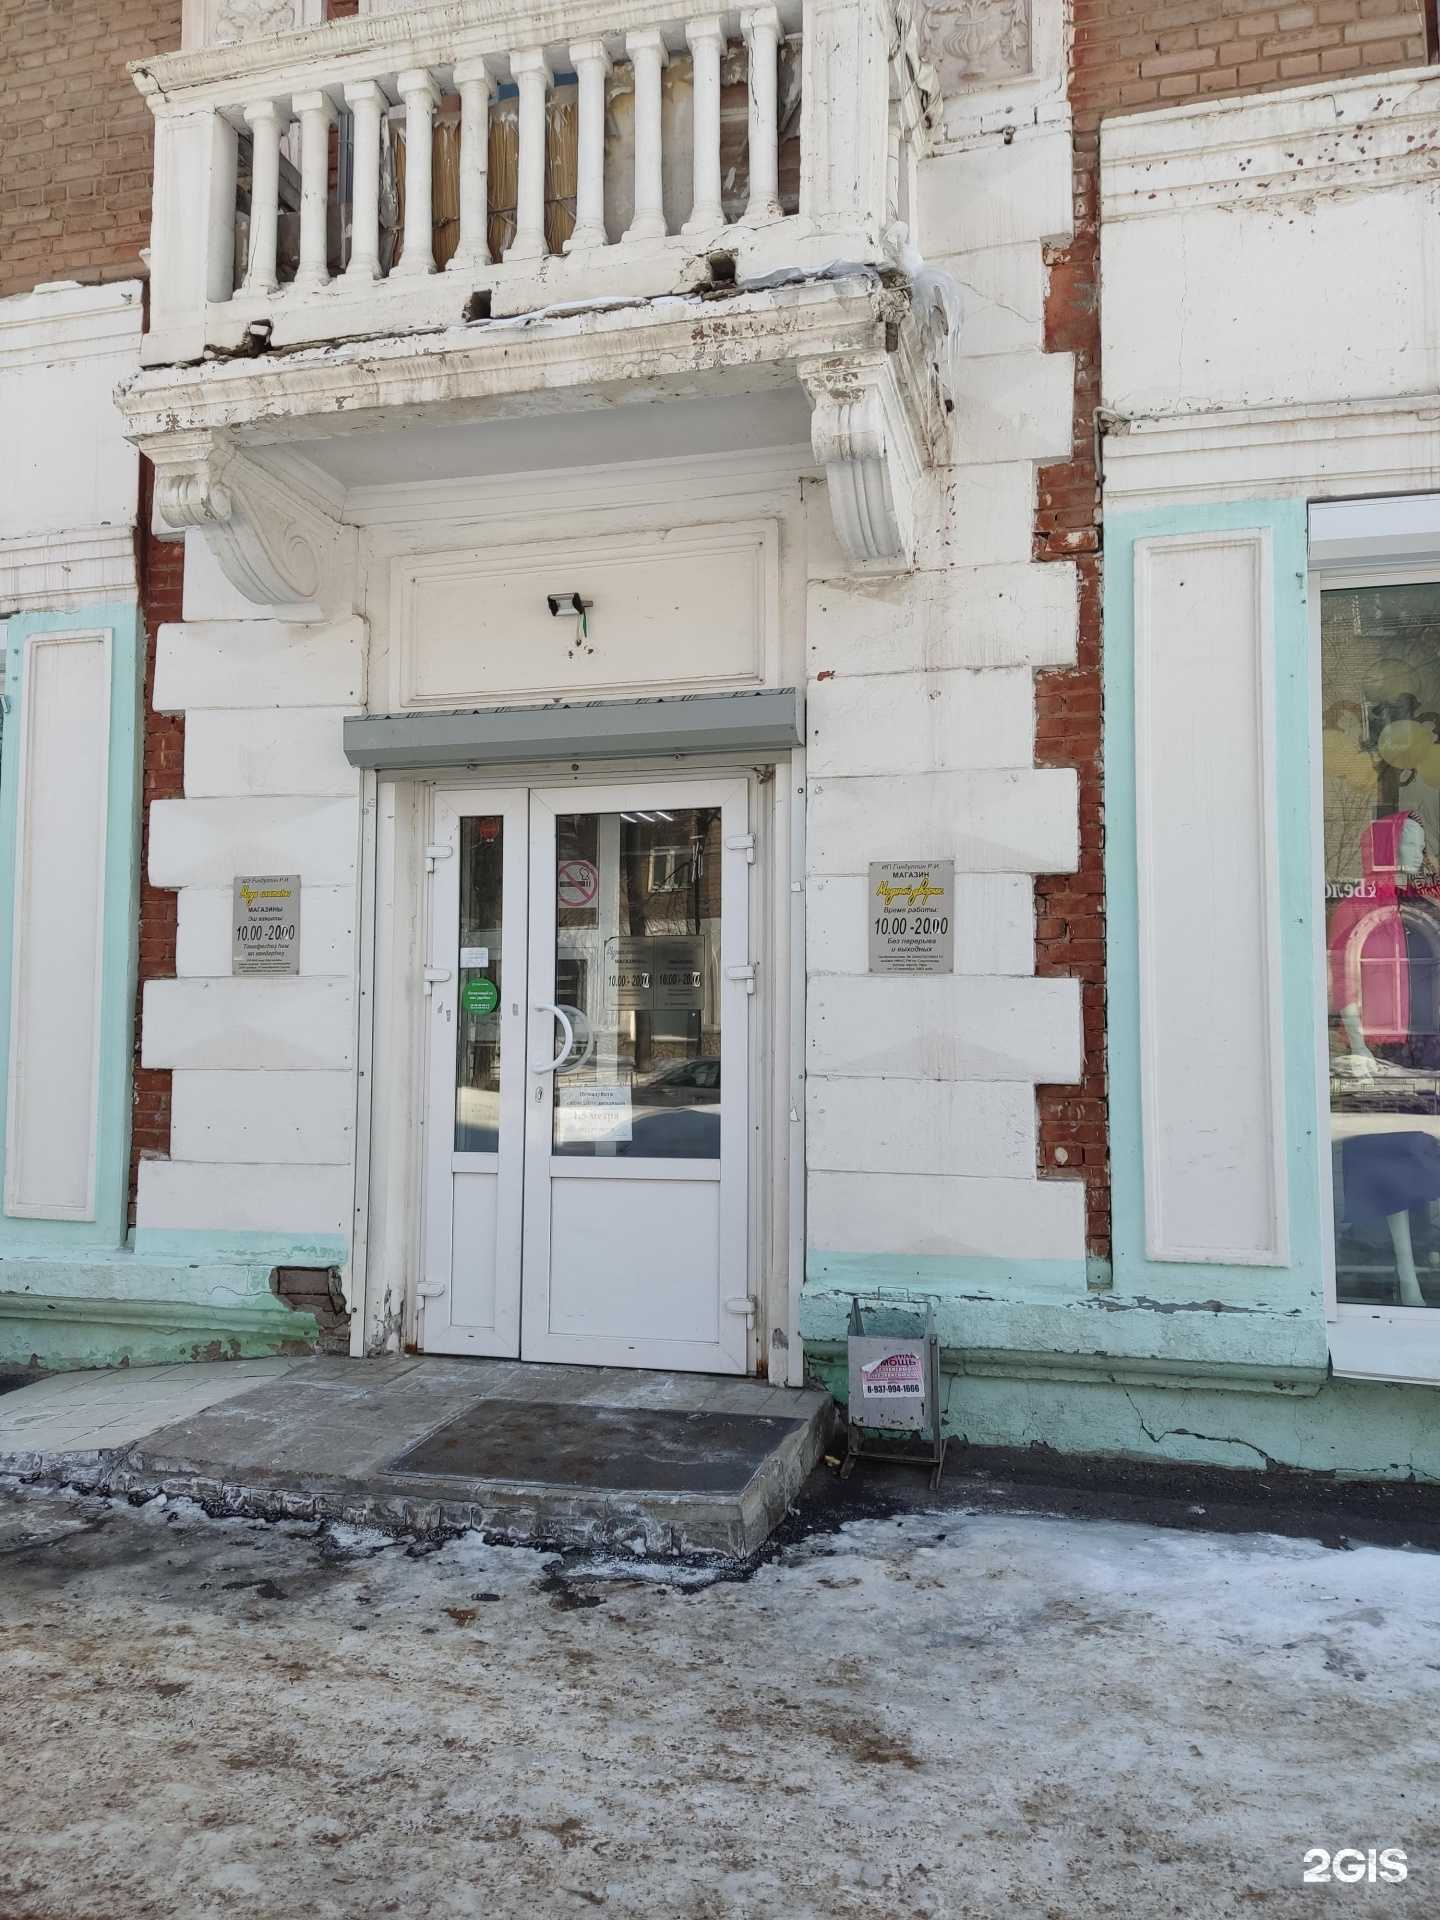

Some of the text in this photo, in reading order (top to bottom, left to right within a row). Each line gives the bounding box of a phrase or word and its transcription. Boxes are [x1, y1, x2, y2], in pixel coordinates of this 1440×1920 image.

[892, 871, 930, 879] МАГАЗИН
[236, 925, 262, 941] 10.00
[874, 917, 907, 935] 10.00
